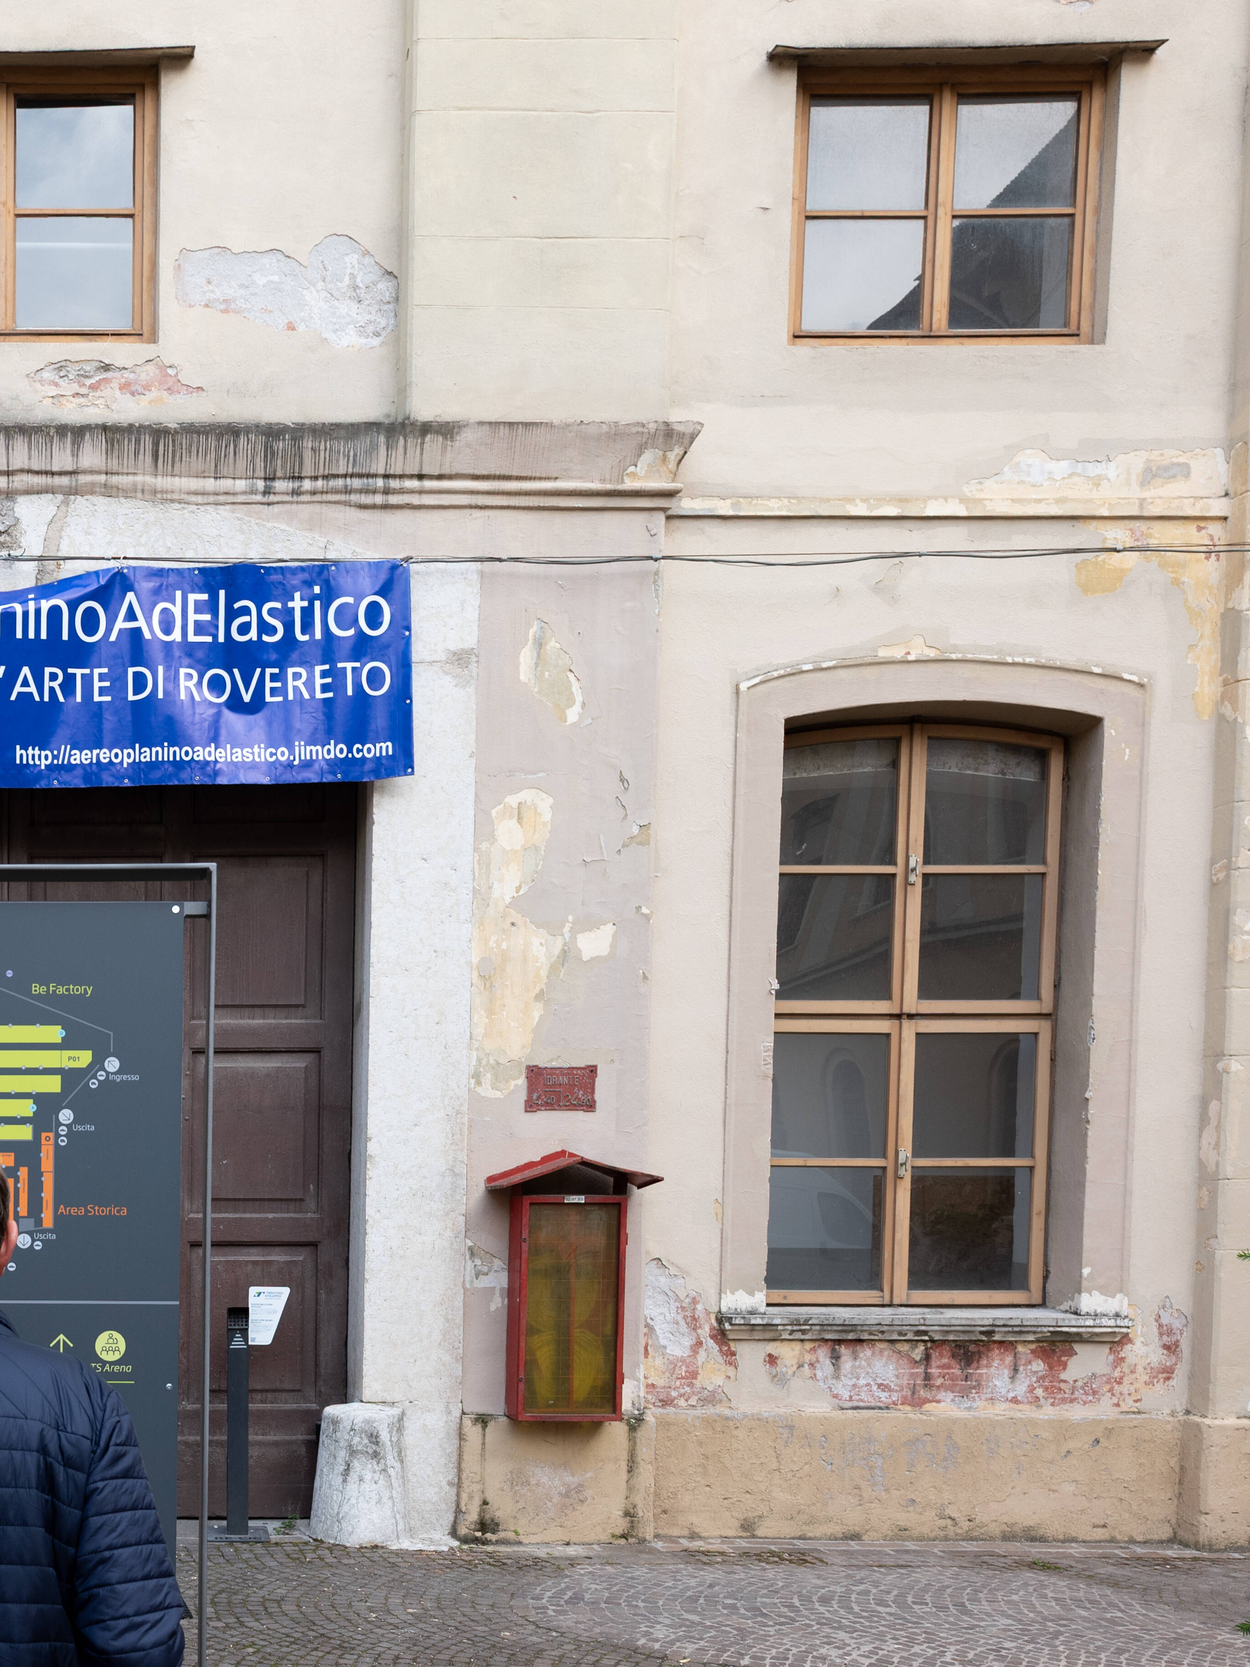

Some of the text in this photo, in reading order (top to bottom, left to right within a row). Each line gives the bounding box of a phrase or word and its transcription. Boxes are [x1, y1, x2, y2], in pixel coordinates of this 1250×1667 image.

[128, 665, 164, 702] DI
[179, 661, 391, 704] ROVERETO
[15, 739, 393, 770] http://aereoplaninoadelastico.jimdo.com
[32, 984, 93, 997] Be Factory
[109, 1074, 139, 1082] Ingresso
[544, 1076, 579, 1085] IDRANTE
[58, 1205, 85, 1215] Area
[87, 1205, 127, 1215] Storica
[103, 1363, 132, 1373] Arena
